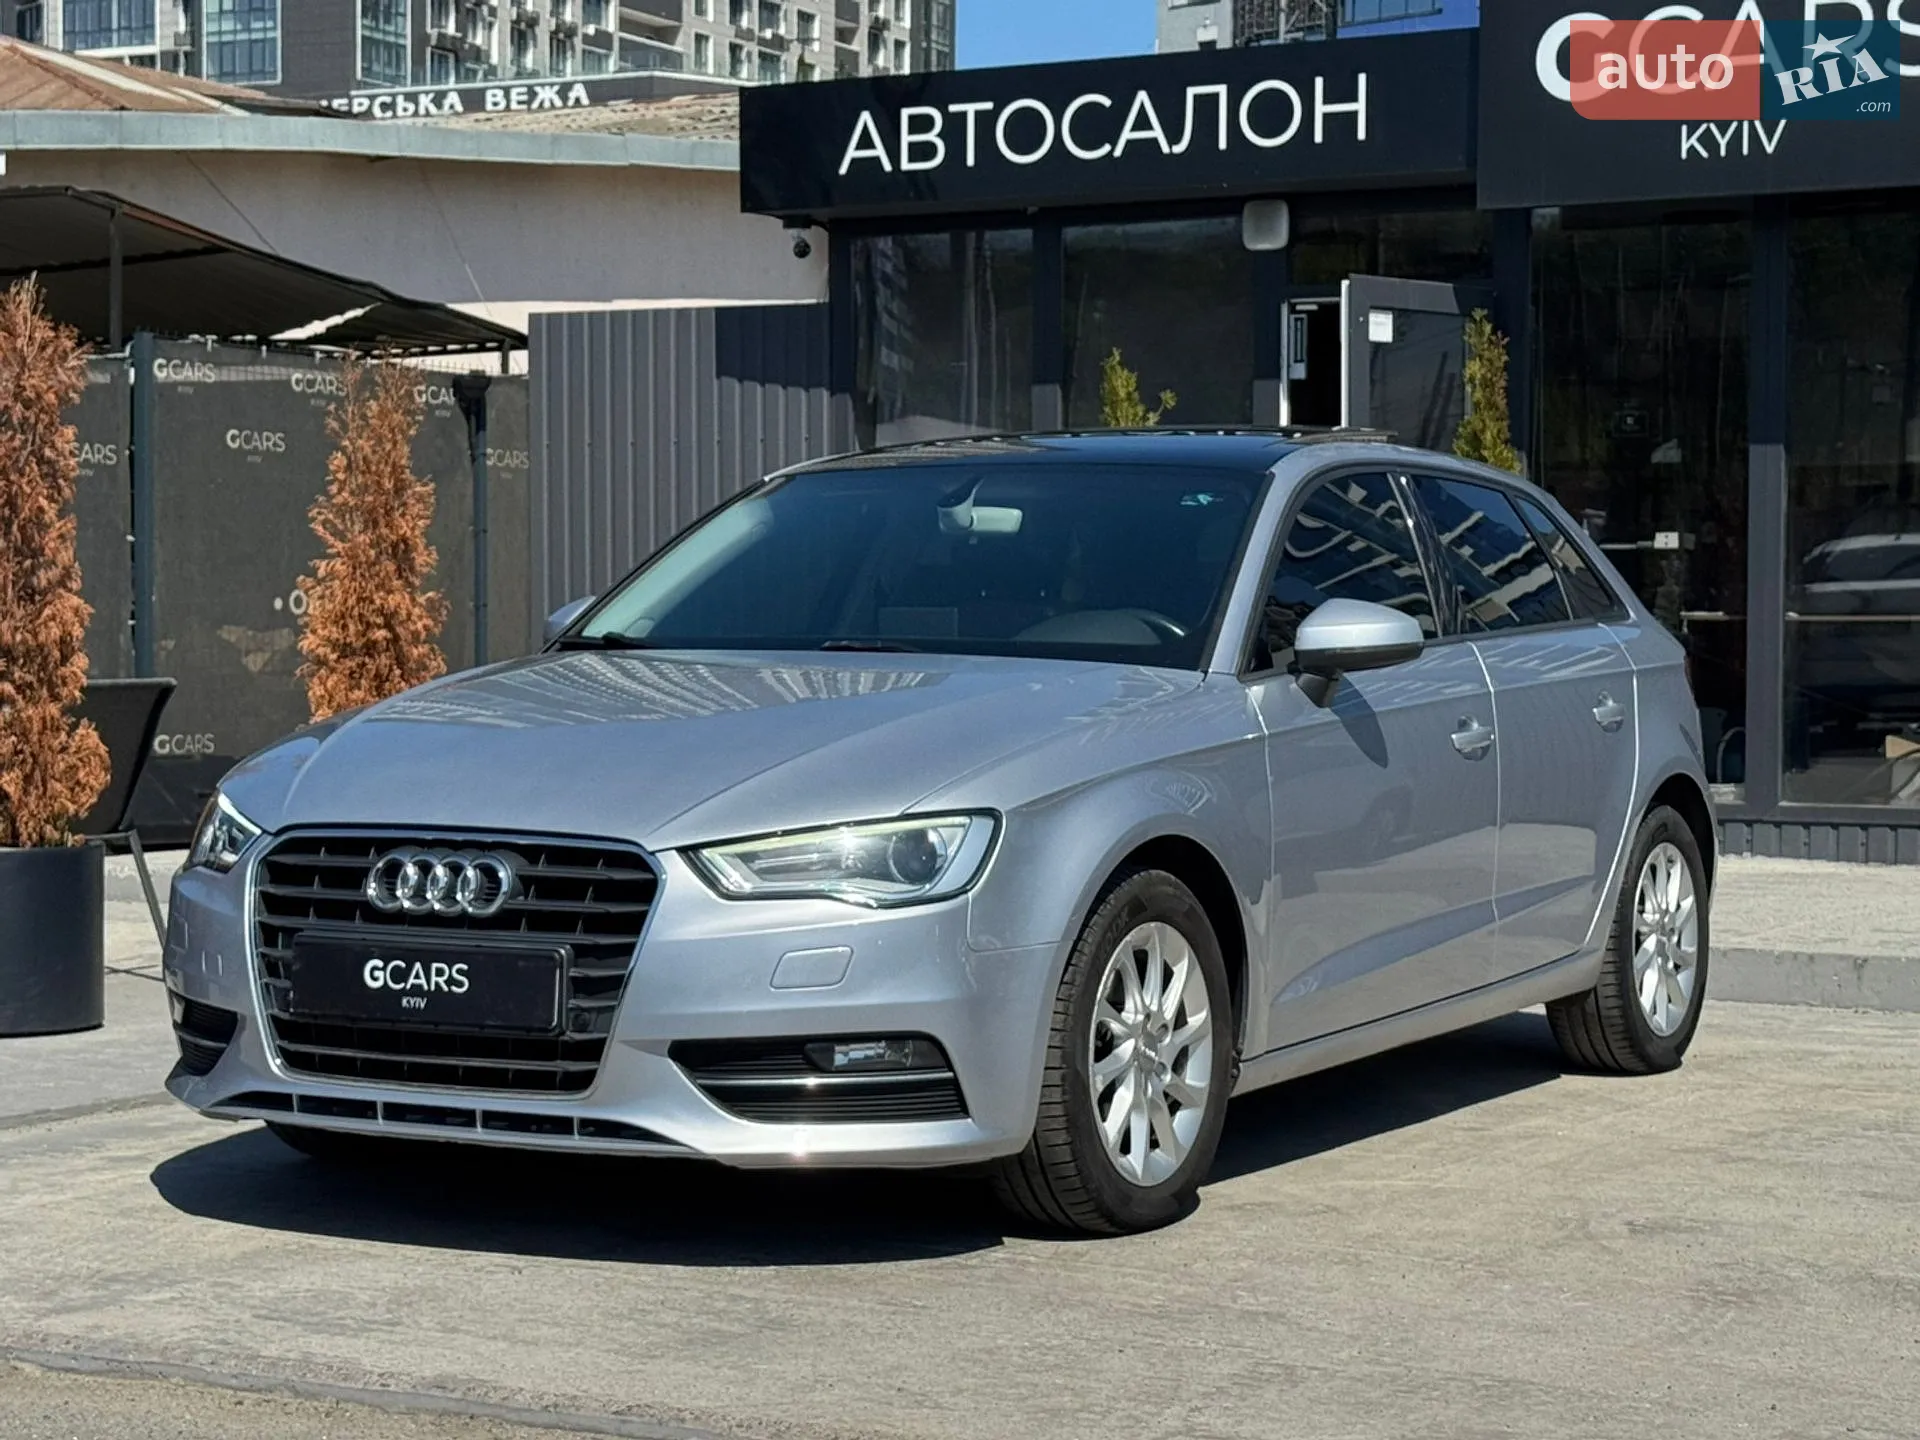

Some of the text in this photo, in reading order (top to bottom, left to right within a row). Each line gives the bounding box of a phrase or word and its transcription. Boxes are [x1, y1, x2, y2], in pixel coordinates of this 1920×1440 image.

[485, 83, 590, 112] ВЕЖА
[838, 72, 1367, 175] АВТОСАЛОН
[1680, 118, 1787, 160] KYIV
[153, 358, 216, 383] GCARS
[226, 429, 286, 452] GCARS
[153, 733, 215, 754] GCARS
[363, 958, 469, 994] GCARS
[401, 996, 427, 1010] KYIV
